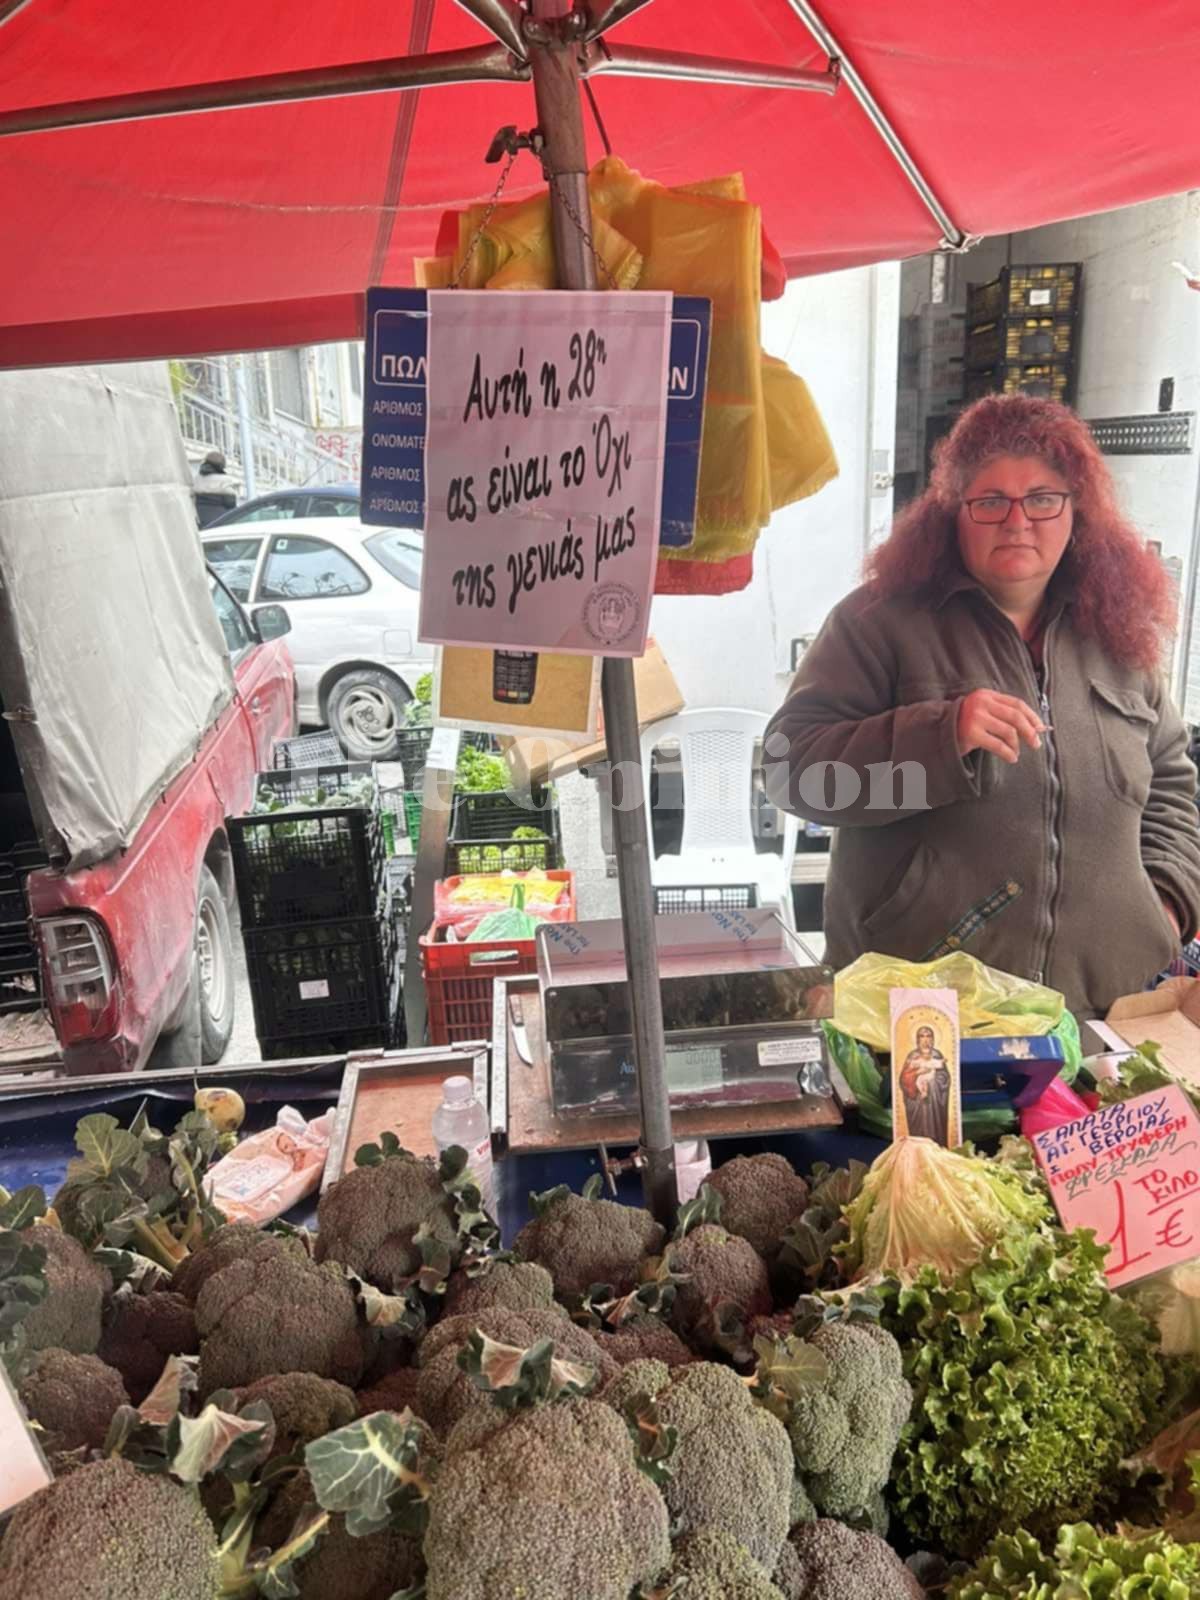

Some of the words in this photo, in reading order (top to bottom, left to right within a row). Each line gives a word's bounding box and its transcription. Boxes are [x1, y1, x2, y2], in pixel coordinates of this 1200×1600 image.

[373, 401, 424, 417] ΑΡΙΘΜΟΣ
[464, 348, 532, 423] Αυτή
[541, 359, 561, 409] η
[371, 466, 421, 482] ΑΡΙΘΜΟΣ
[447, 475, 478, 523] ας
[487, 445, 552, 514] είναι
[559, 445, 585, 487] το
[592, 413, 632, 498] Όχι
[369, 498, 420, 514] ΑΡΙΘΜΟΣ
[452, 563, 497, 610] της
[507, 518, 584, 615] γενιάς
[594, 505, 636, 583] μας
[1089, 1108, 1174, 1156] ΒΕΡΟΙΑΣ
[1102, 1115, 1188, 1161] ΤΡΥΦΕΡΗ
[1132, 1168, 1168, 1191] ΤΟ
[1104, 1179, 1152, 1276] 1
[1155, 1207, 1194, 1248] €
